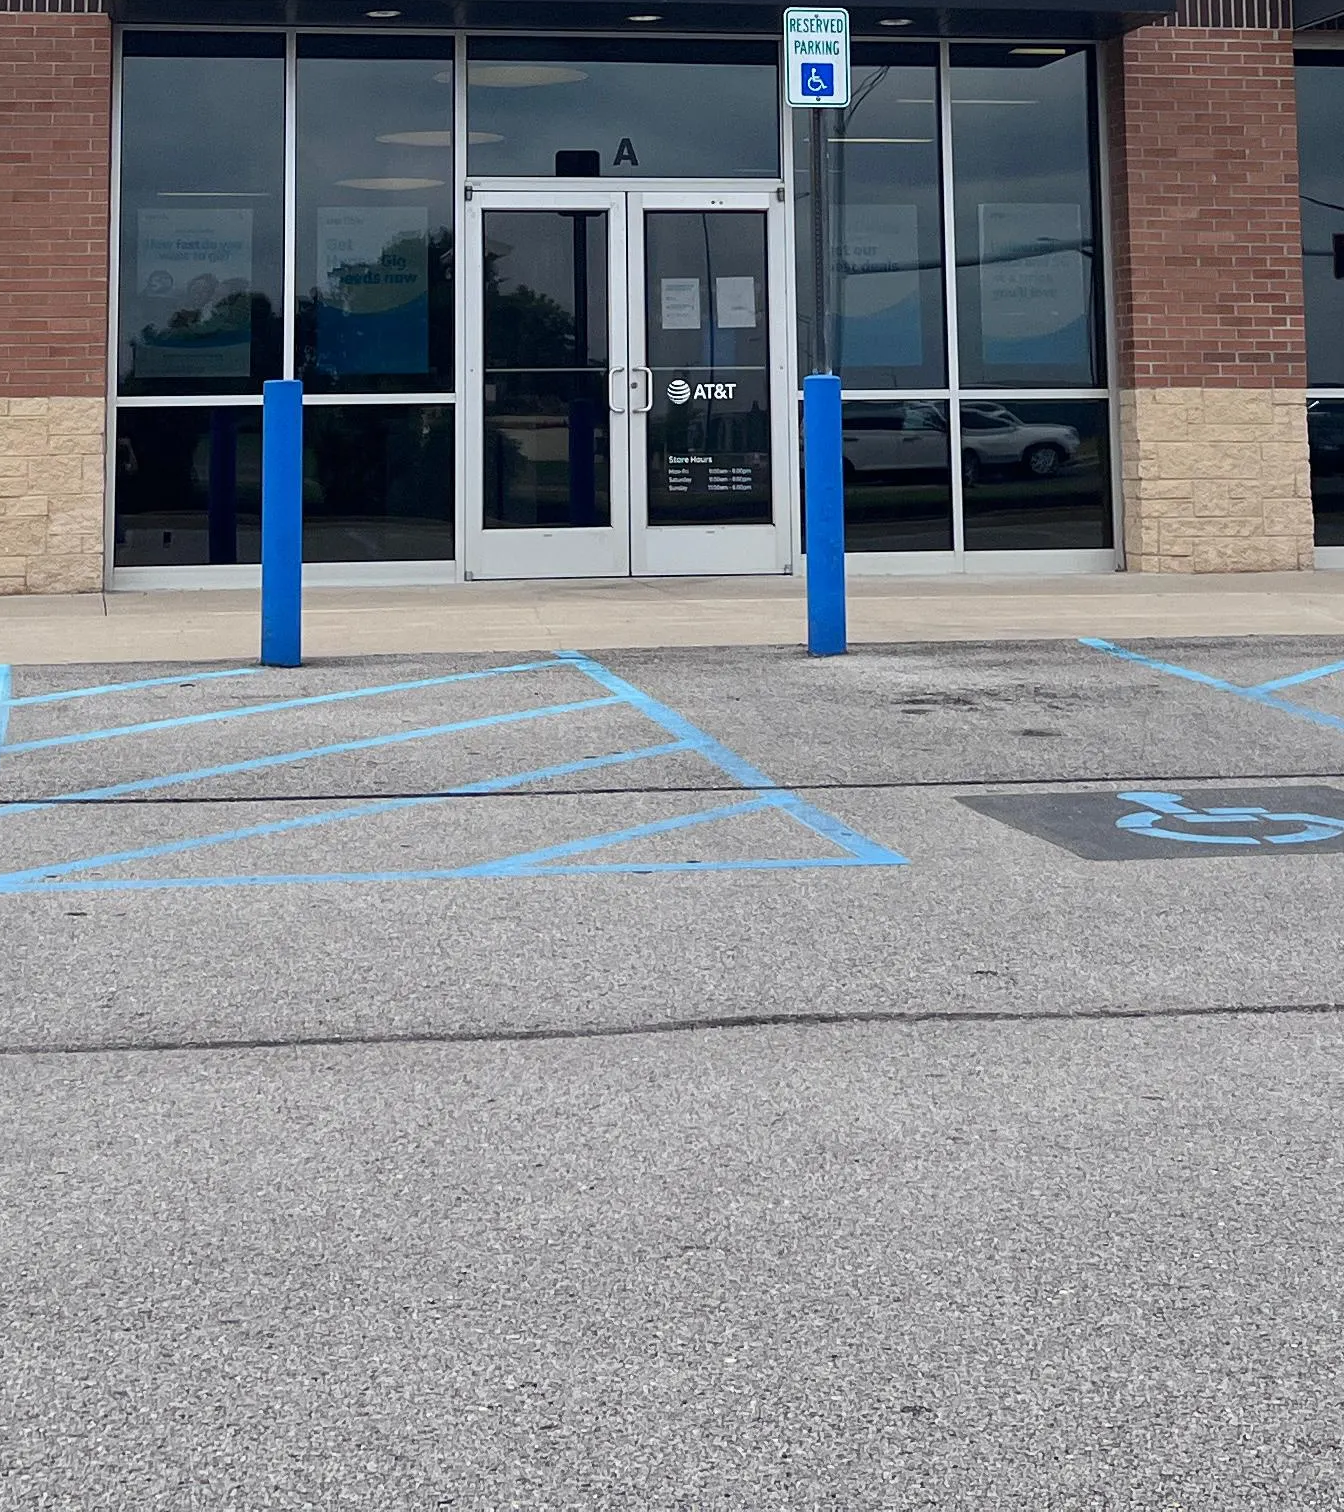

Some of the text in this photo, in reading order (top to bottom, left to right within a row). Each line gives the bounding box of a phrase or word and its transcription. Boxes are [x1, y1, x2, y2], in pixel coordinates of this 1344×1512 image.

[789, 18, 844, 33] RESERVED
[794, 40, 840, 55] PARKING
[613, 138, 639, 166] A
[693, 383, 737, 399] AT&T
[668, 455, 713, 463] Store Hours
